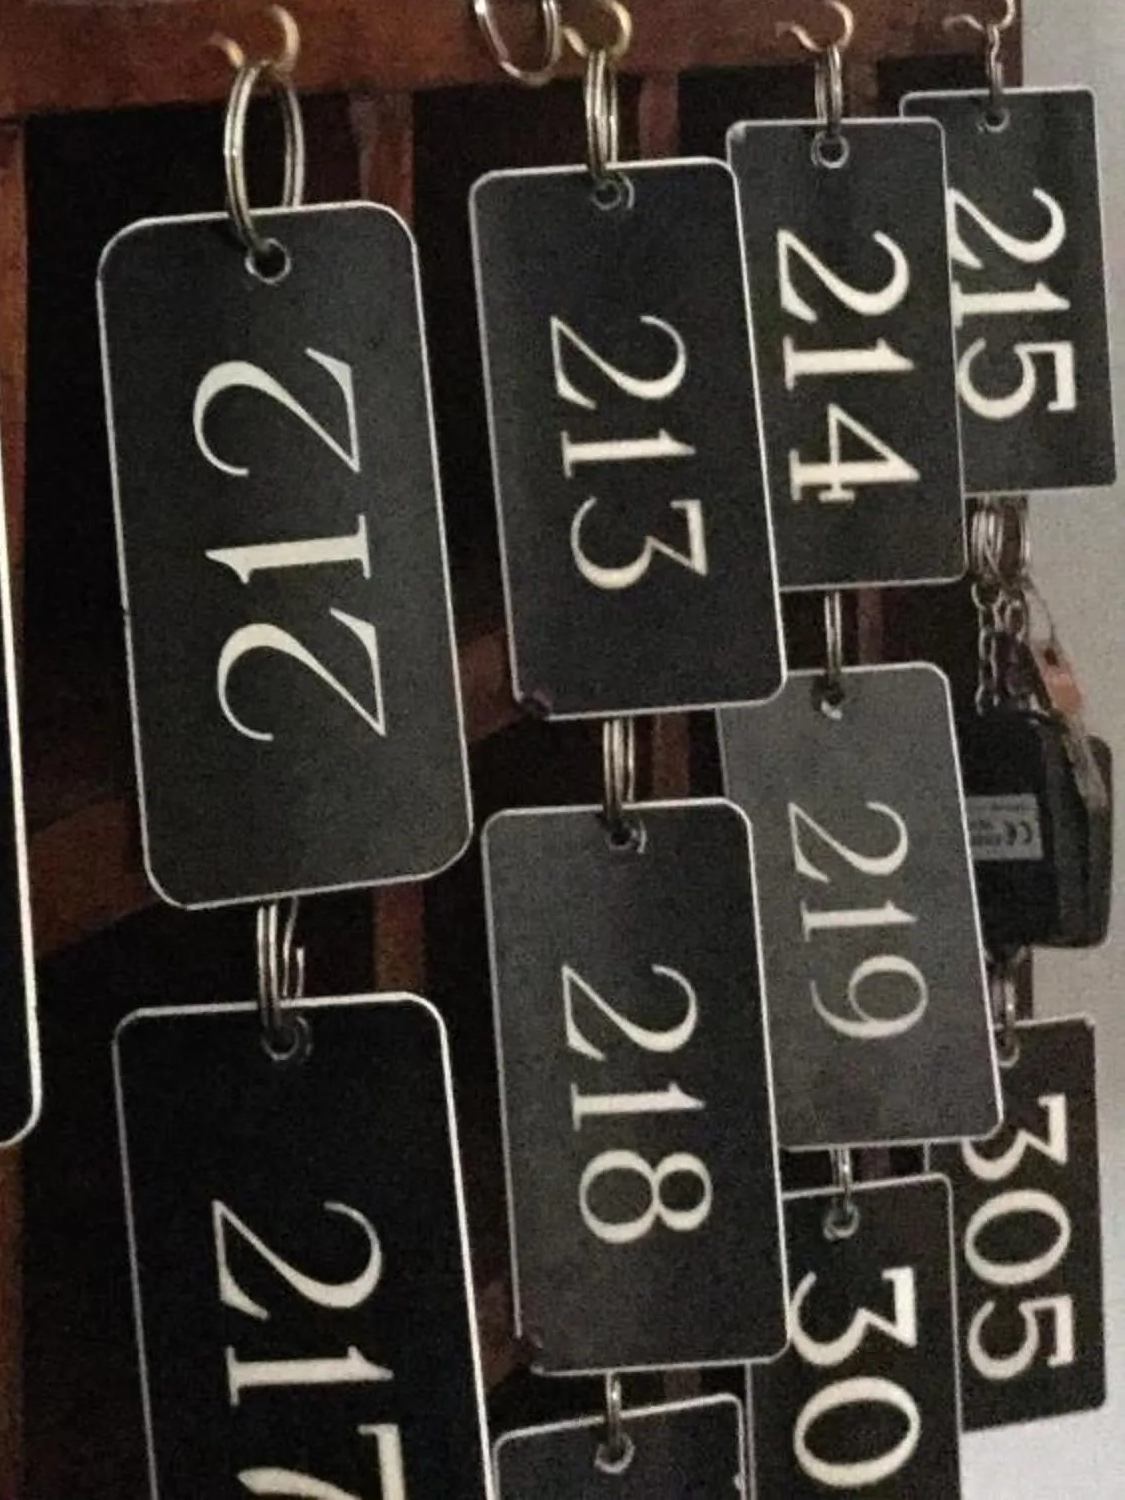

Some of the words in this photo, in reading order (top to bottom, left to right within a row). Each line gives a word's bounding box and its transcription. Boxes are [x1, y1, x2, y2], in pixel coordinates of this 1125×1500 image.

[777, 229, 920, 502] 214
[947, 187, 1077, 420] 215
[193, 347, 386, 741] 212
[551, 315, 708, 590] 213
[788, 801, 929, 1039] 219
[562, 964, 712, 1244] 218
[962, 1094, 1075, 1380] 305
